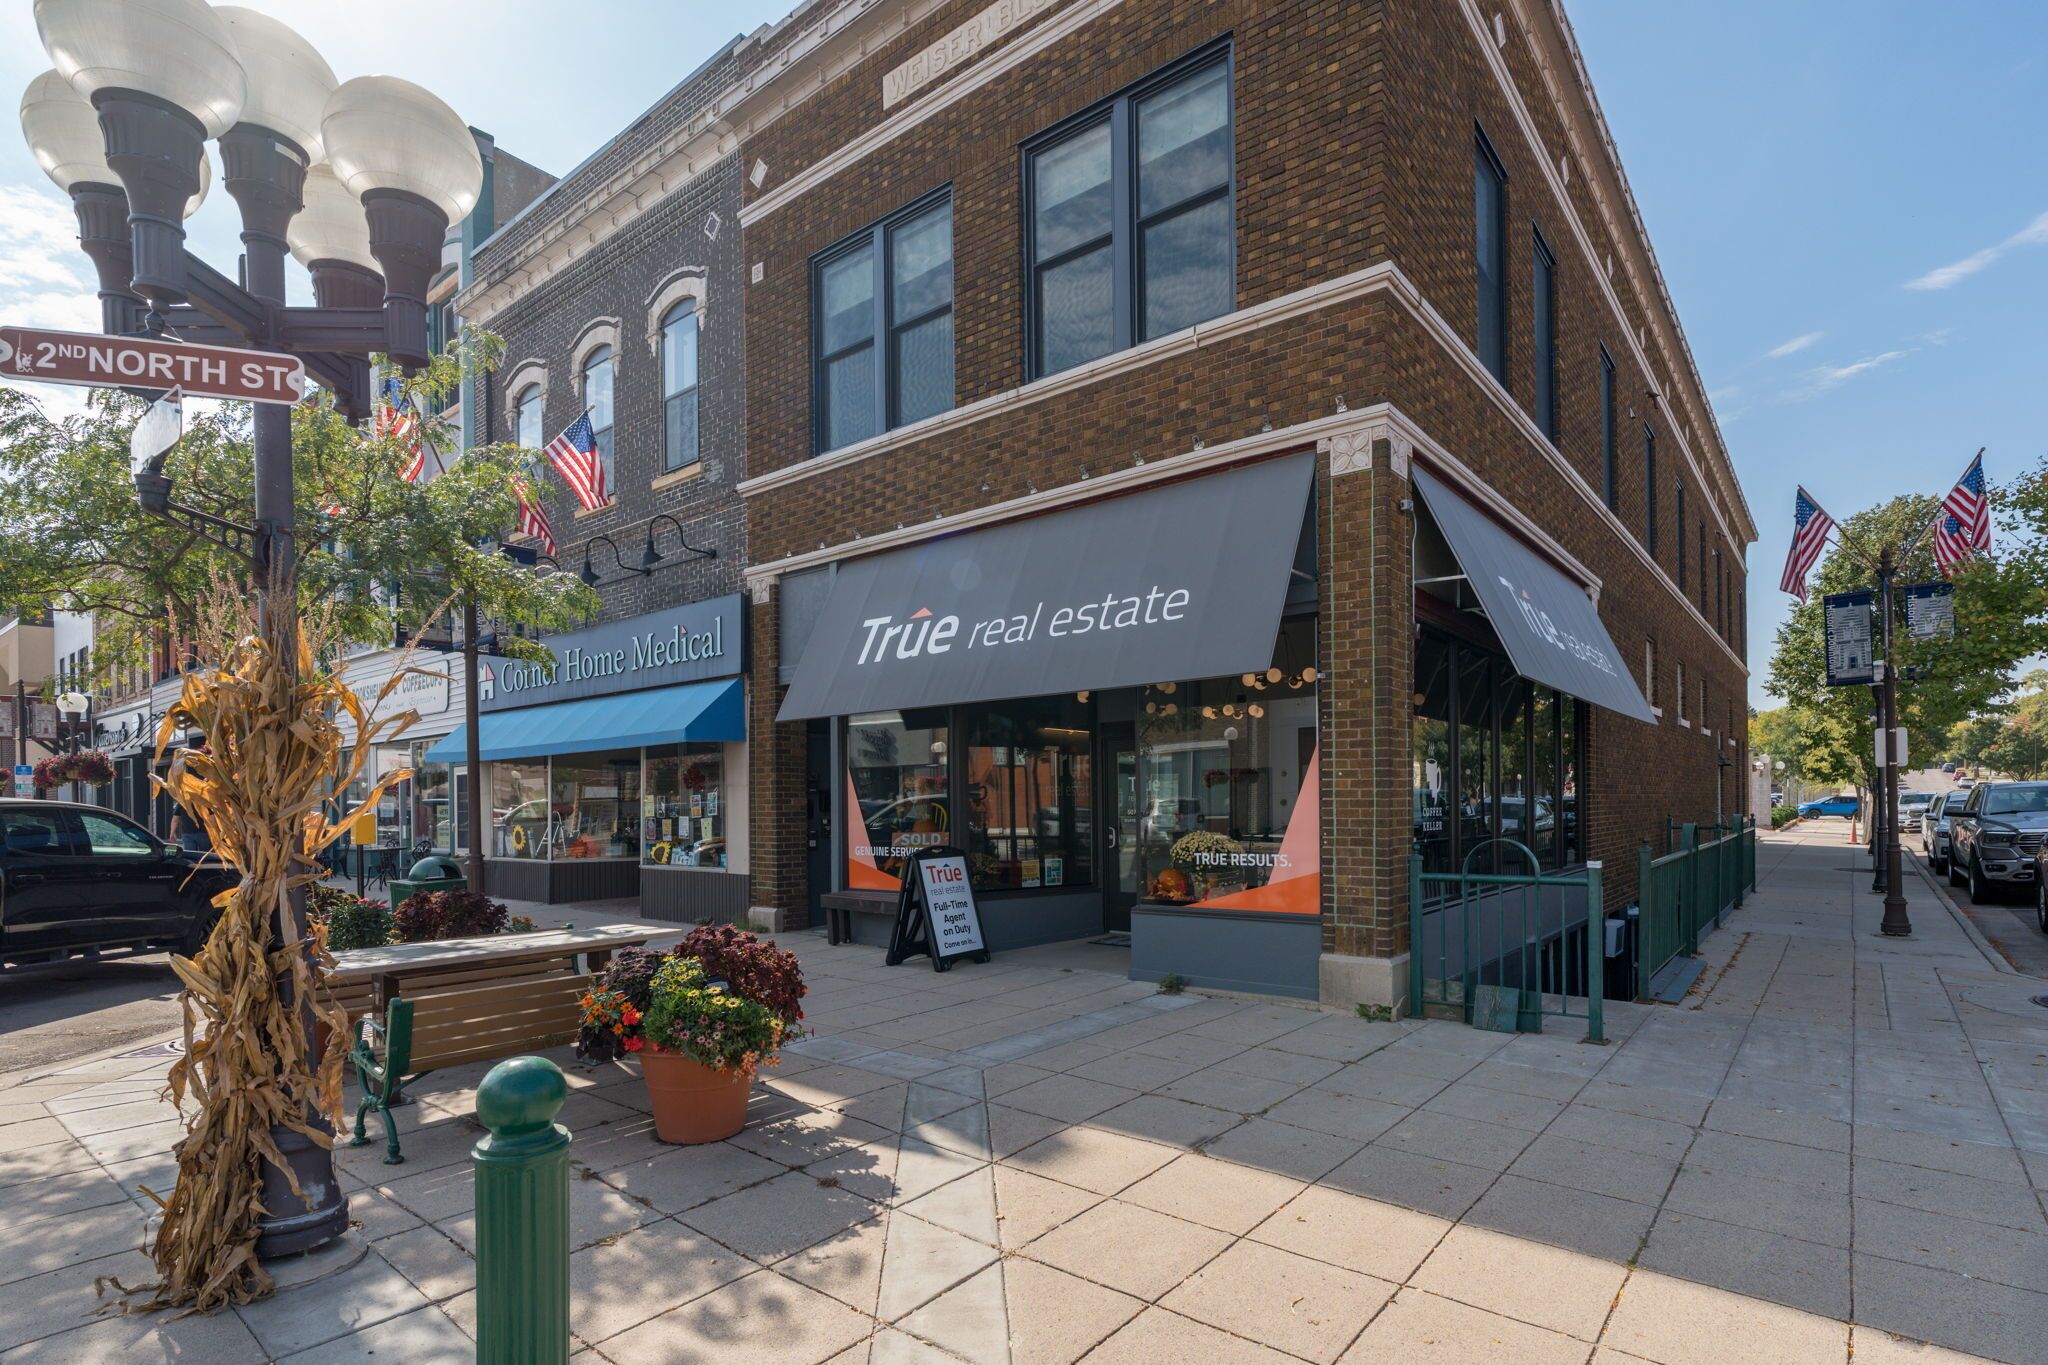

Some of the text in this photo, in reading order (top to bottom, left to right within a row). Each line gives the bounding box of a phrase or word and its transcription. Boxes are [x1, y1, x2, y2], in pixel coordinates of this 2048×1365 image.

[890, 23, 985, 100] WEISER
[88, 345, 227, 386] NORTH
[239, 362, 289, 392] ST
[857, 585, 1190, 666] True real estate
[564, 647, 626, 682] Home
[631, 615, 724, 672] Medical
[1422, 807, 1443, 817] COFFEE
[1422, 821, 1443, 832] KELLER
[900, 833, 941, 846] SOLD
[854, 846, 890, 857] GENUINE
[1194, 852, 1292, 868] TRUE RESULTS.
[926, 863, 963, 884] True
[930, 884, 966, 897] real estate
[933, 900, 969, 913] Full-Time
[944, 912, 966, 924] Agent
[943, 925, 971, 936] on Duty
[944, 940, 960, 949] Come
